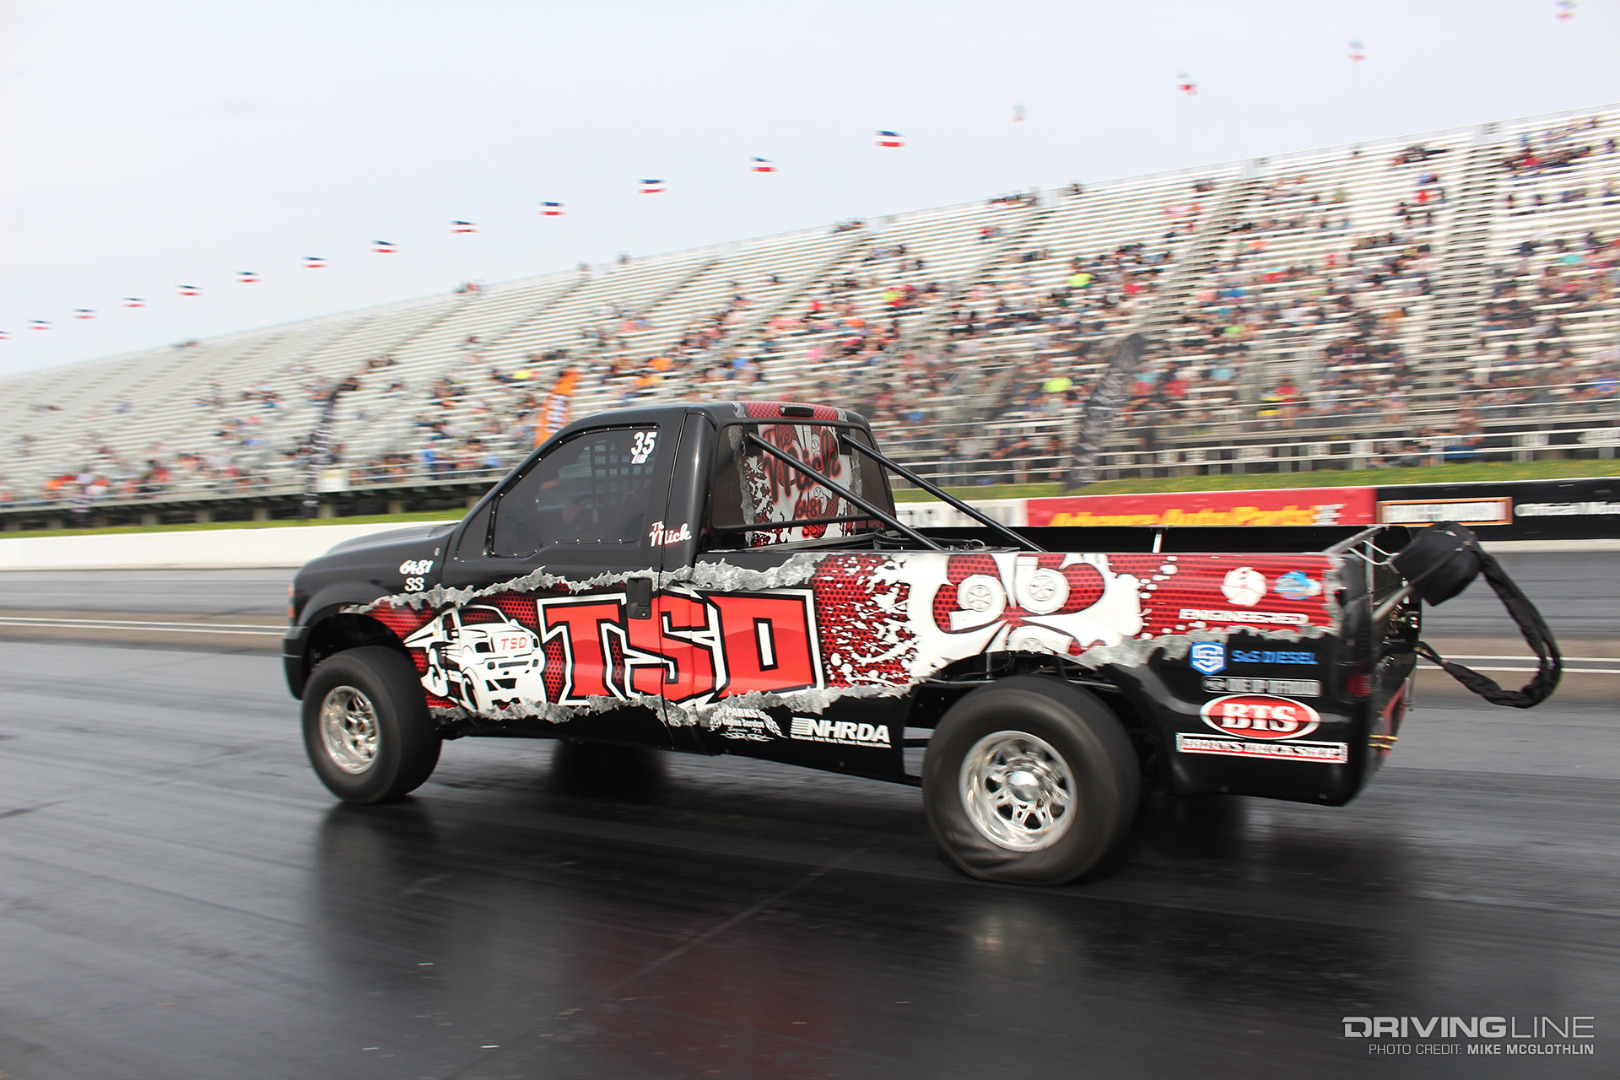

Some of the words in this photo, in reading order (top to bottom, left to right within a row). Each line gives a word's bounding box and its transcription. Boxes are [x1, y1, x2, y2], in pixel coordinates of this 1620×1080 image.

[631, 431, 657, 456] 35
[795, 498, 822, 520] 6481
[648, 522, 692, 547] Mick
[399, 559, 434, 575] 6481
[404, 577, 425, 592] SS
[501, 636, 527, 650] TSD
[536, 591, 823, 706] TSD
[1221, 702, 1300, 732] BTS
[791, 717, 891, 743] NHRDA
